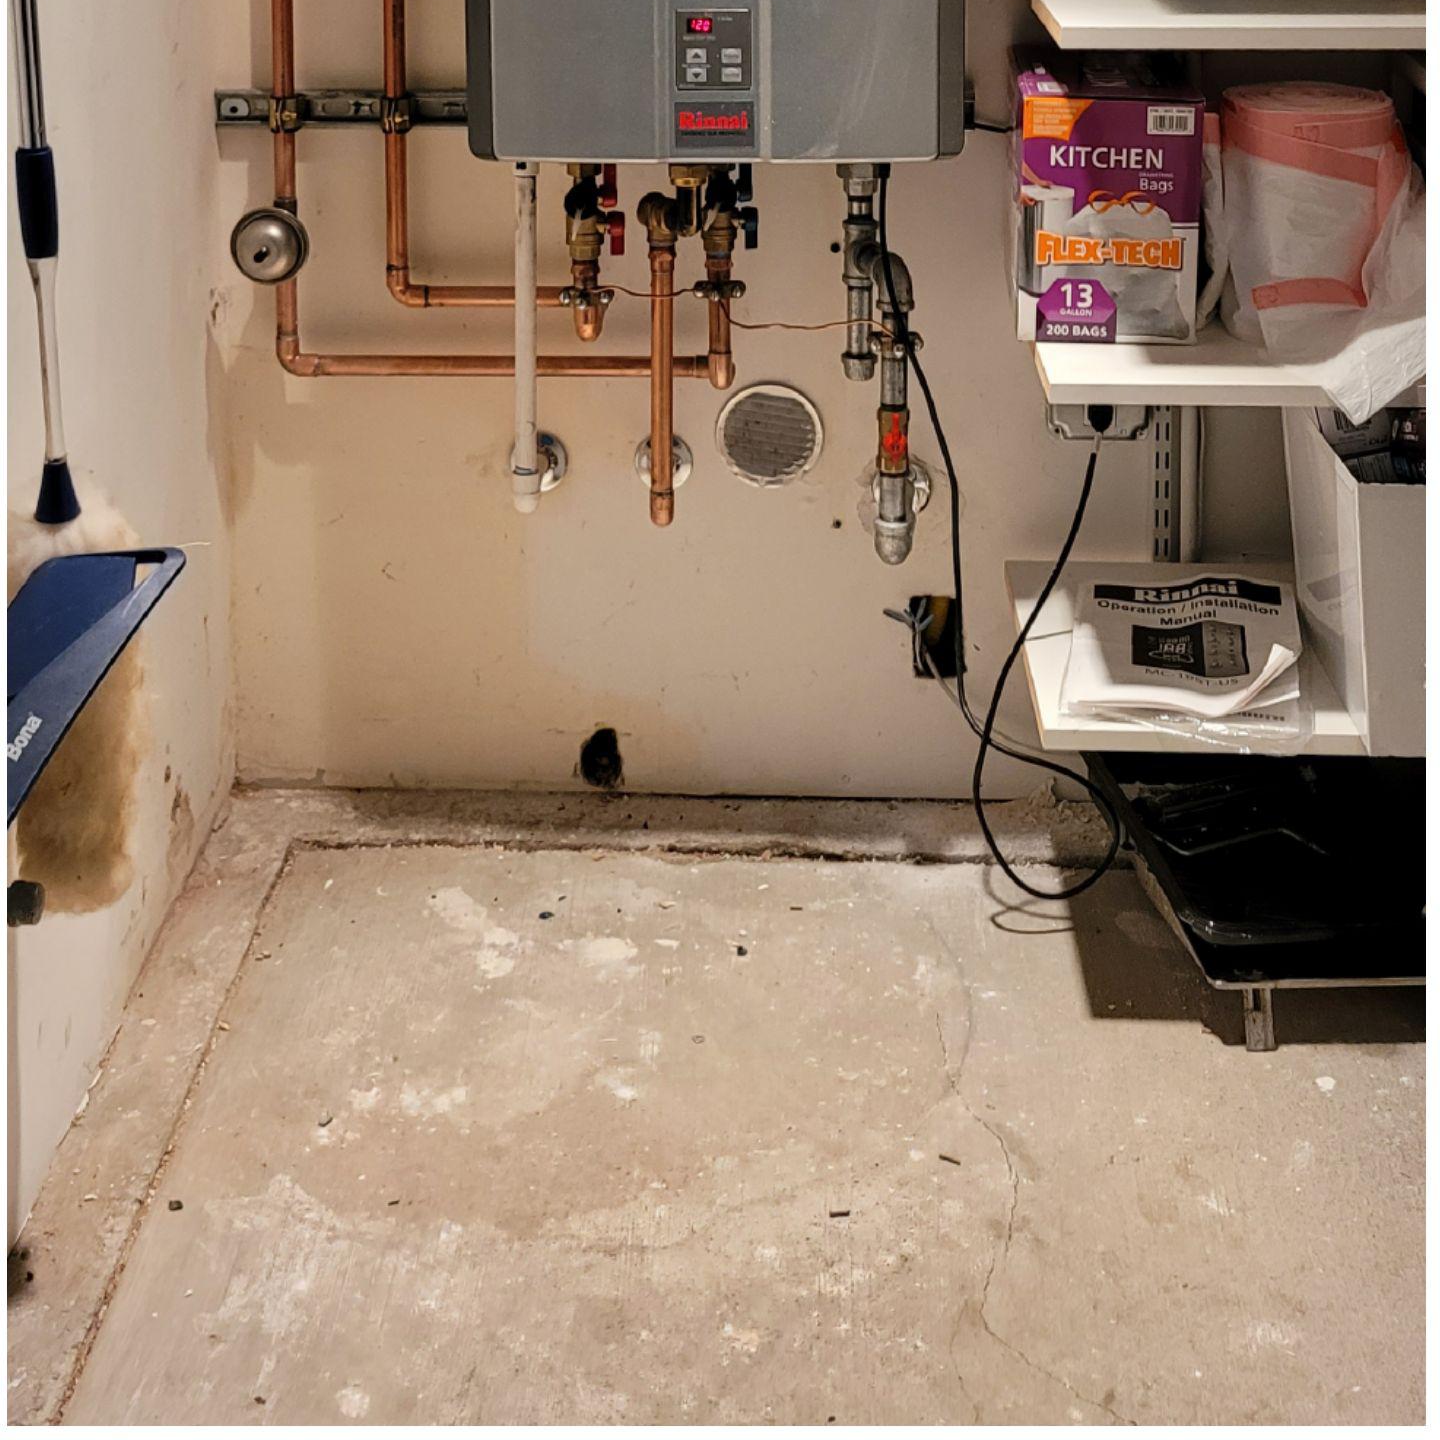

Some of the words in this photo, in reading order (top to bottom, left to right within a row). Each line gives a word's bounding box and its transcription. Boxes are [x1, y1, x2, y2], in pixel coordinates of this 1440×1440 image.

[690, 20, 710, 31] 120
[678, 111, 748, 129] Rinnai
[1049, 145, 1163, 169] KITCHEN
[1139, 177, 1174, 195] Bags
[1036, 232, 1182, 268] FLEX-TECH
[1060, 283, 1093, 308] 13
[1059, 308, 1093, 317] GALLON
[1046, 324, 1070, 336] 200
[1072, 324, 1108, 338] BAGS
[1133, 580, 1239, 603] Rinnai
[1097, 599, 1176, 615] Operation
[1190, 600, 1280, 616] Installation
[1159, 610, 1217, 626] Manual
[7, 714, 43, 763] Bona
